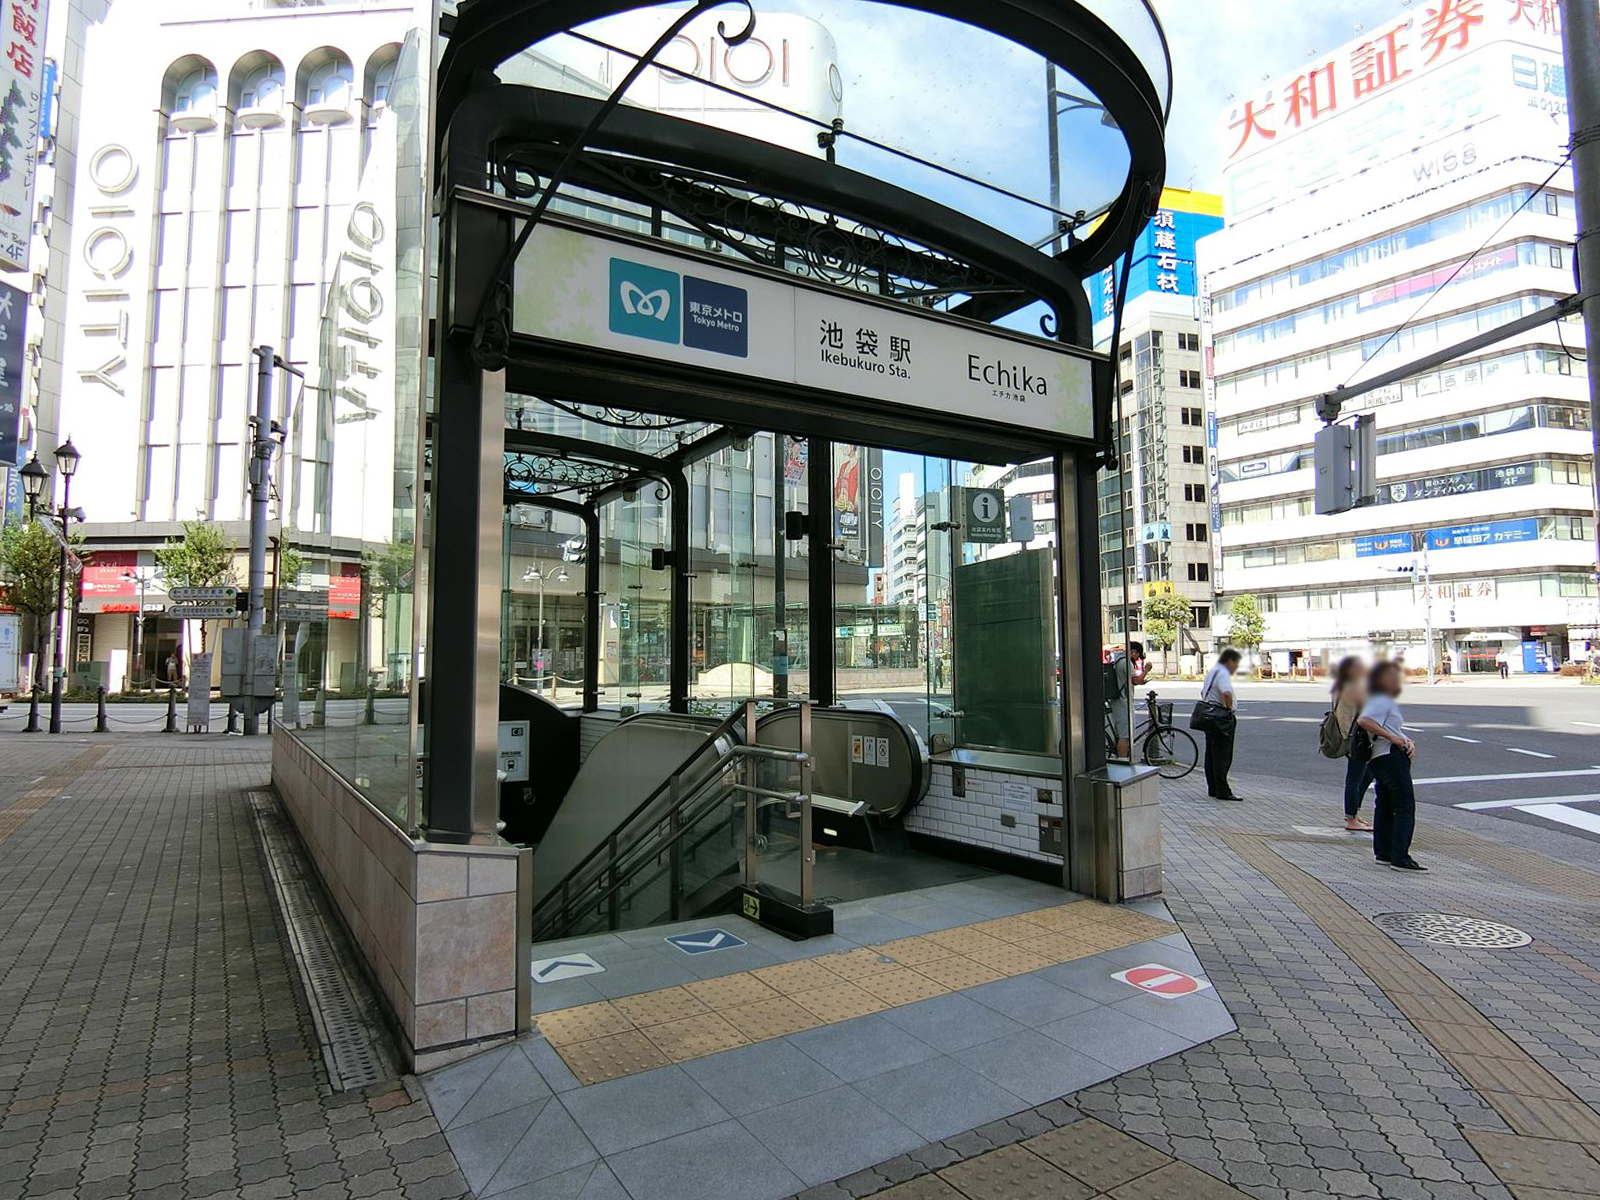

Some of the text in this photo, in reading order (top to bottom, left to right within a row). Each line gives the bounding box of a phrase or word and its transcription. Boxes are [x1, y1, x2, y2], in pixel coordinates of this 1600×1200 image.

[1228, 0, 1484, 160] 大和証券
[689, 301, 743, 323] 東京メトロ
[693, 314, 740, 332] Tokyo Metro
[819, 319, 912, 364] 池袋駅
[820, 349, 911, 379] Ikebukuro Sta.
[967, 354, 1048, 396] Echika
[992, 390, 1026, 403] エチカ池袋
[1495, 467, 1525, 478] 池袋店
[1503, 477, 1518, 485] 4F
[870, 467, 882, 528] OICITY
[1414, 483, 1475, 498] ダンディハウス
[1419, 582, 1492, 600] 大和証券
